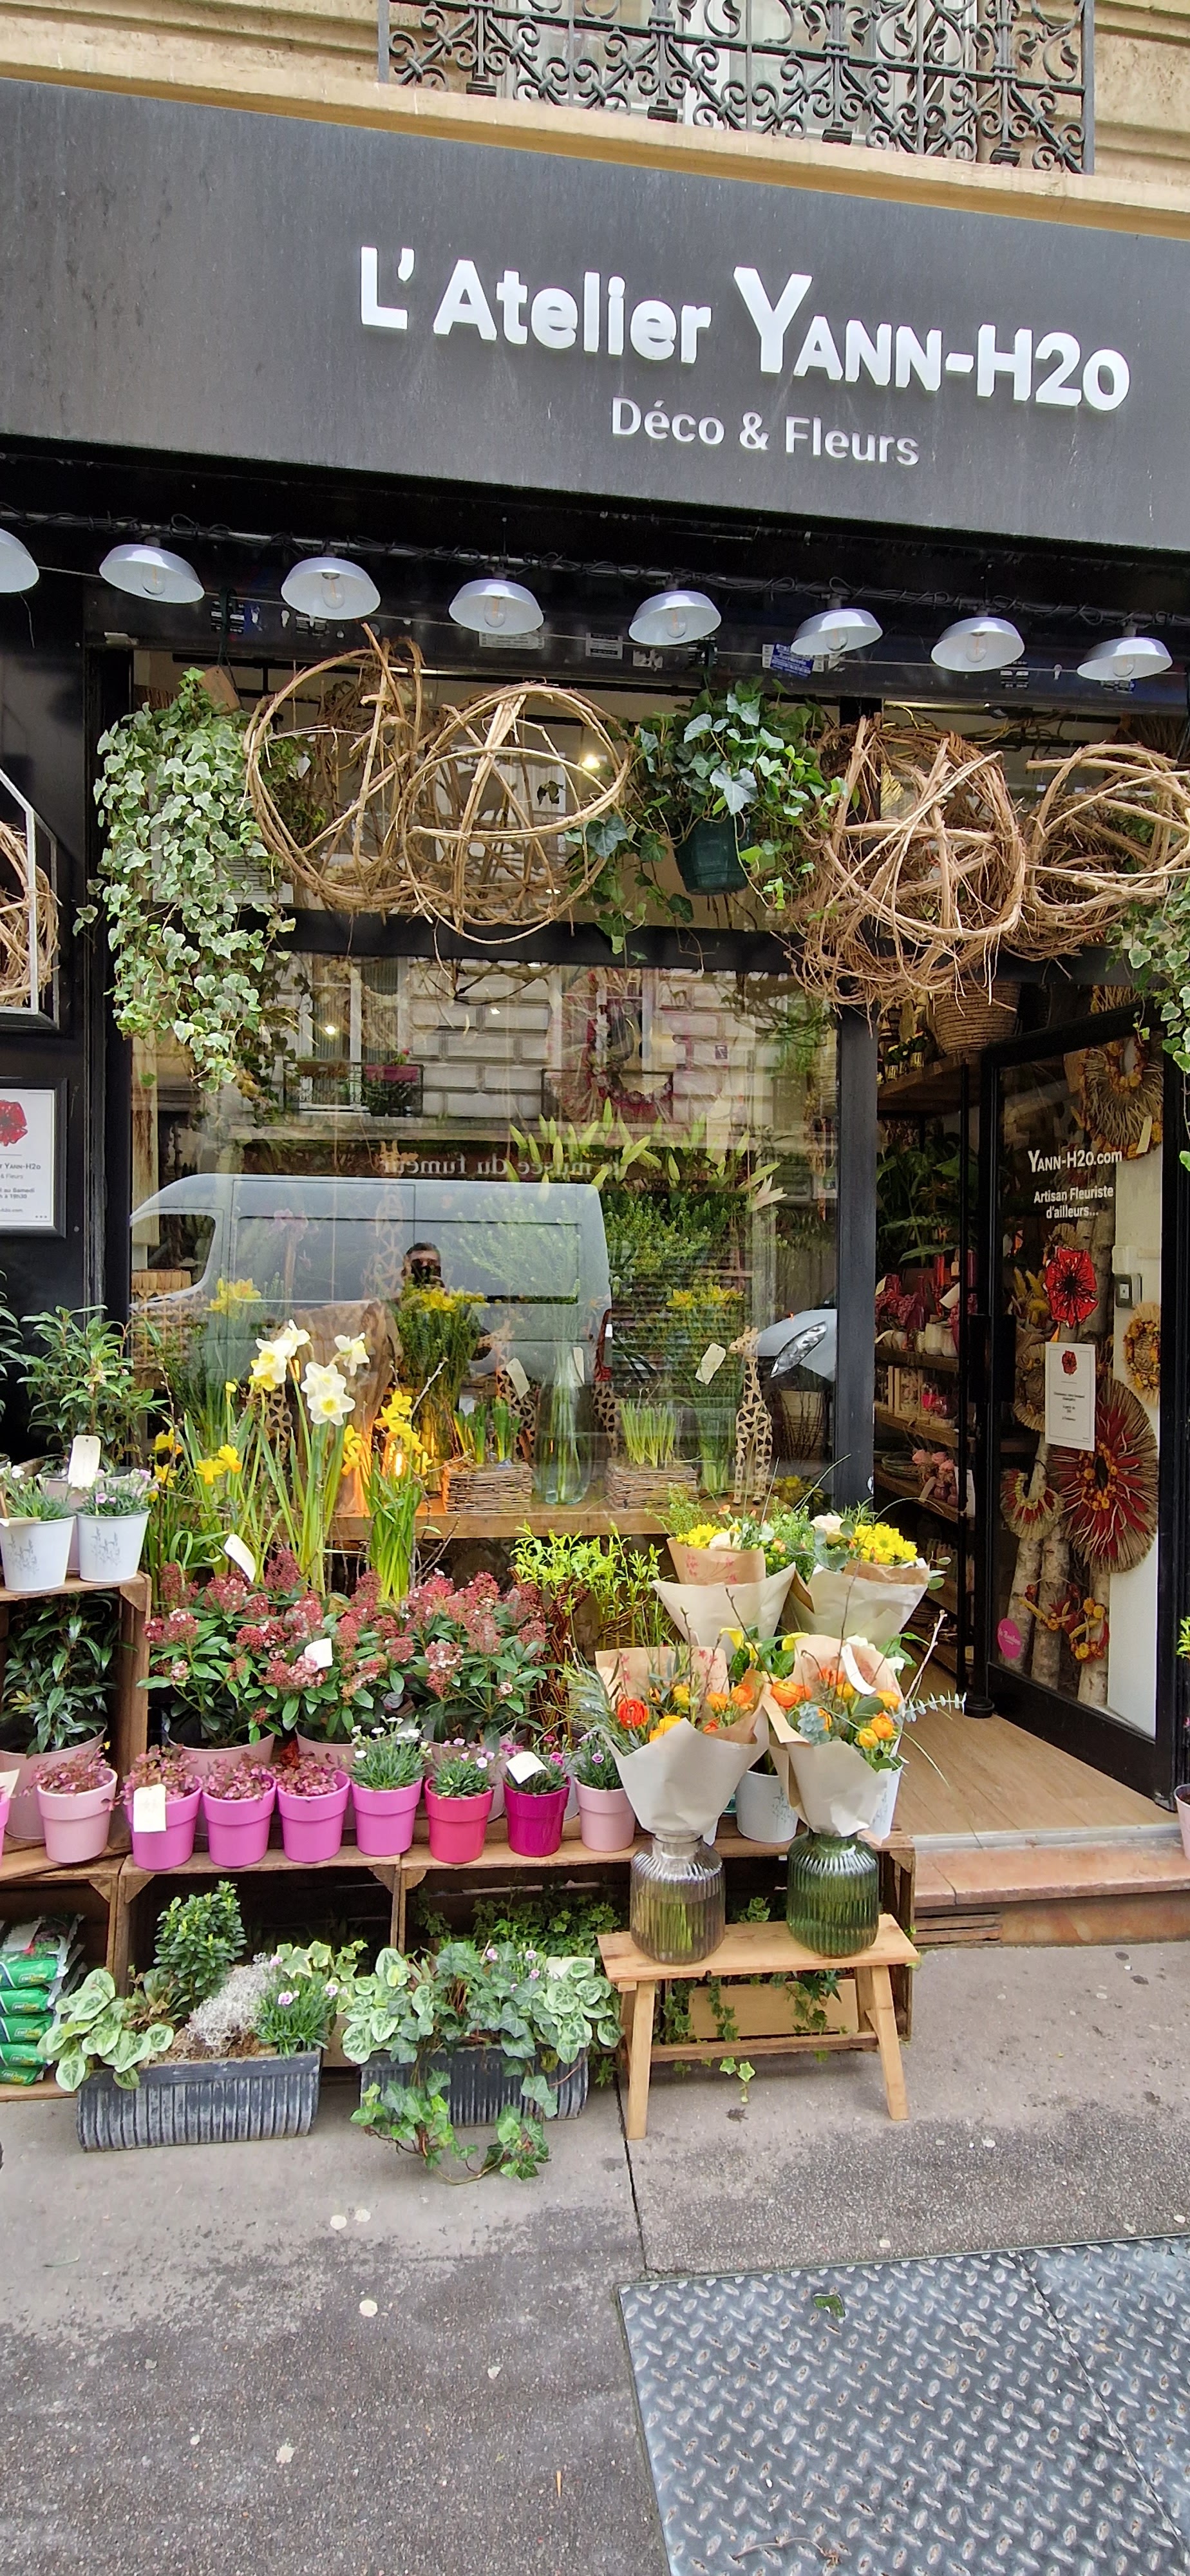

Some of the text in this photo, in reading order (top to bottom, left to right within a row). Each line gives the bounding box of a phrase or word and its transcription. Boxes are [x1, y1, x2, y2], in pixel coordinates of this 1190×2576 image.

[433, 259, 712, 365] Atelier
[611, 397, 920, 466] Déco & Fleurs
[1034, 1185, 1114, 1204] Artisan Fleuriste
[1046, 1204, 1099, 1219] d'ailleurs...
